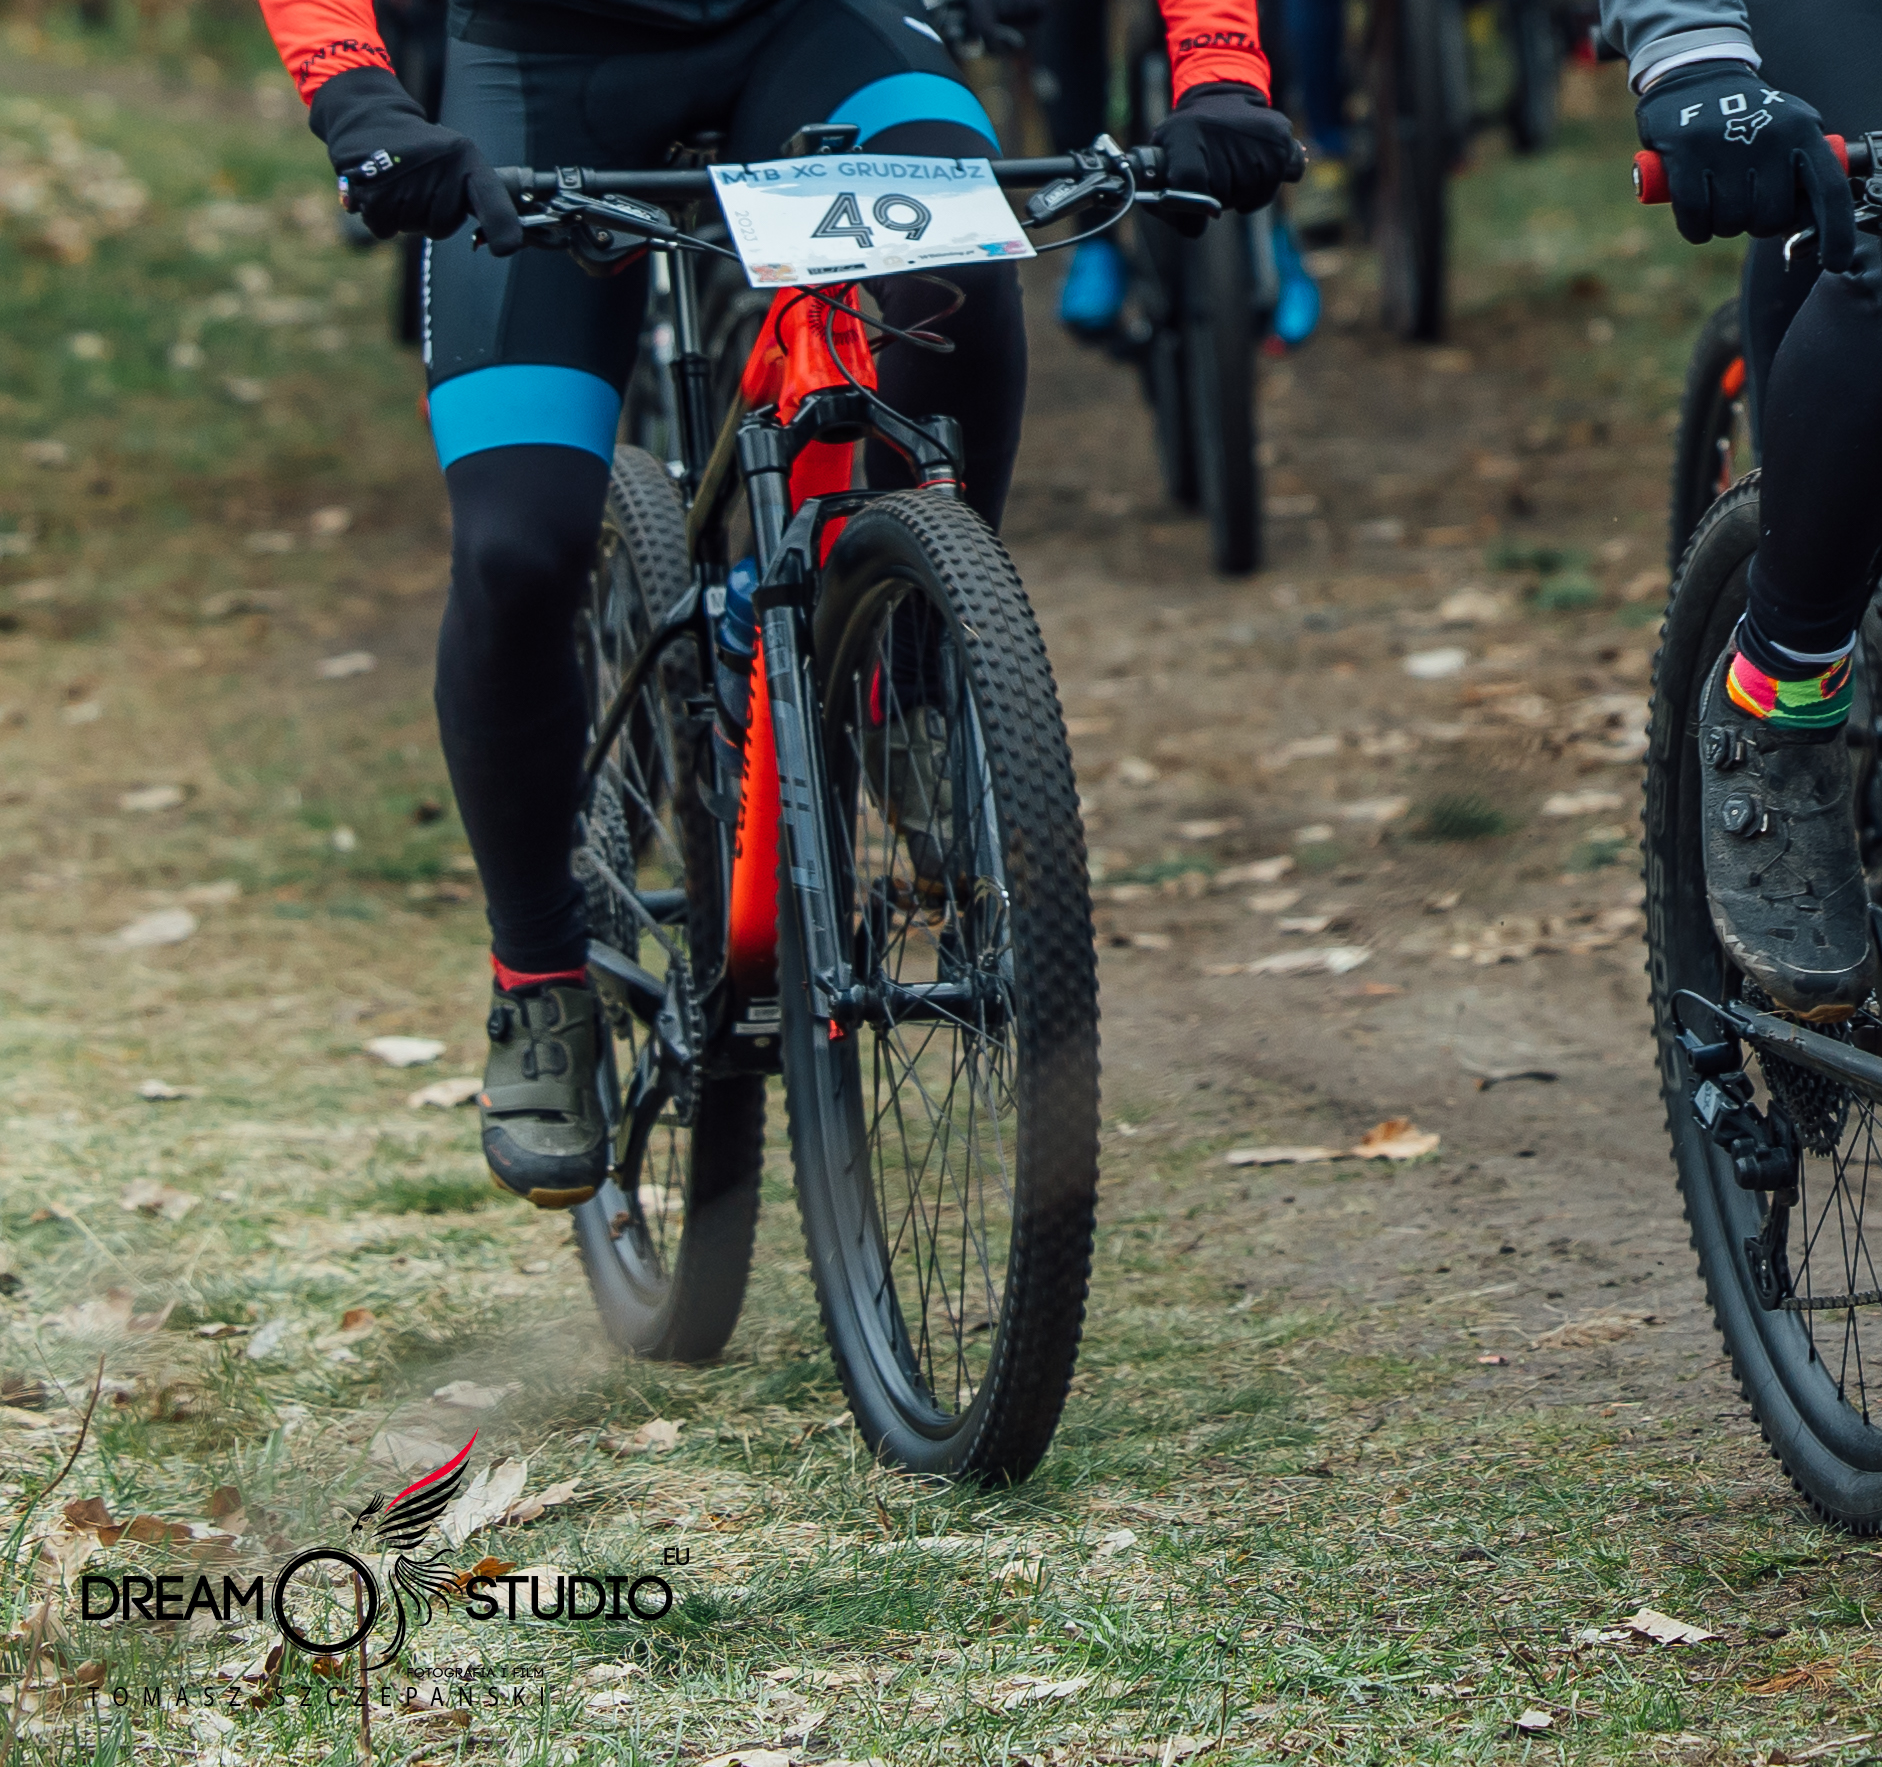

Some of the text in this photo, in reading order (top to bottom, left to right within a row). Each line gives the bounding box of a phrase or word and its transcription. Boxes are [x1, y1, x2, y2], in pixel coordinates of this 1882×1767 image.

[1679, 88, 1785, 127] FOX
[721, 167, 781, 184] MTB
[791, 163, 828, 179] XC
[809, 191, 933, 249] 49
